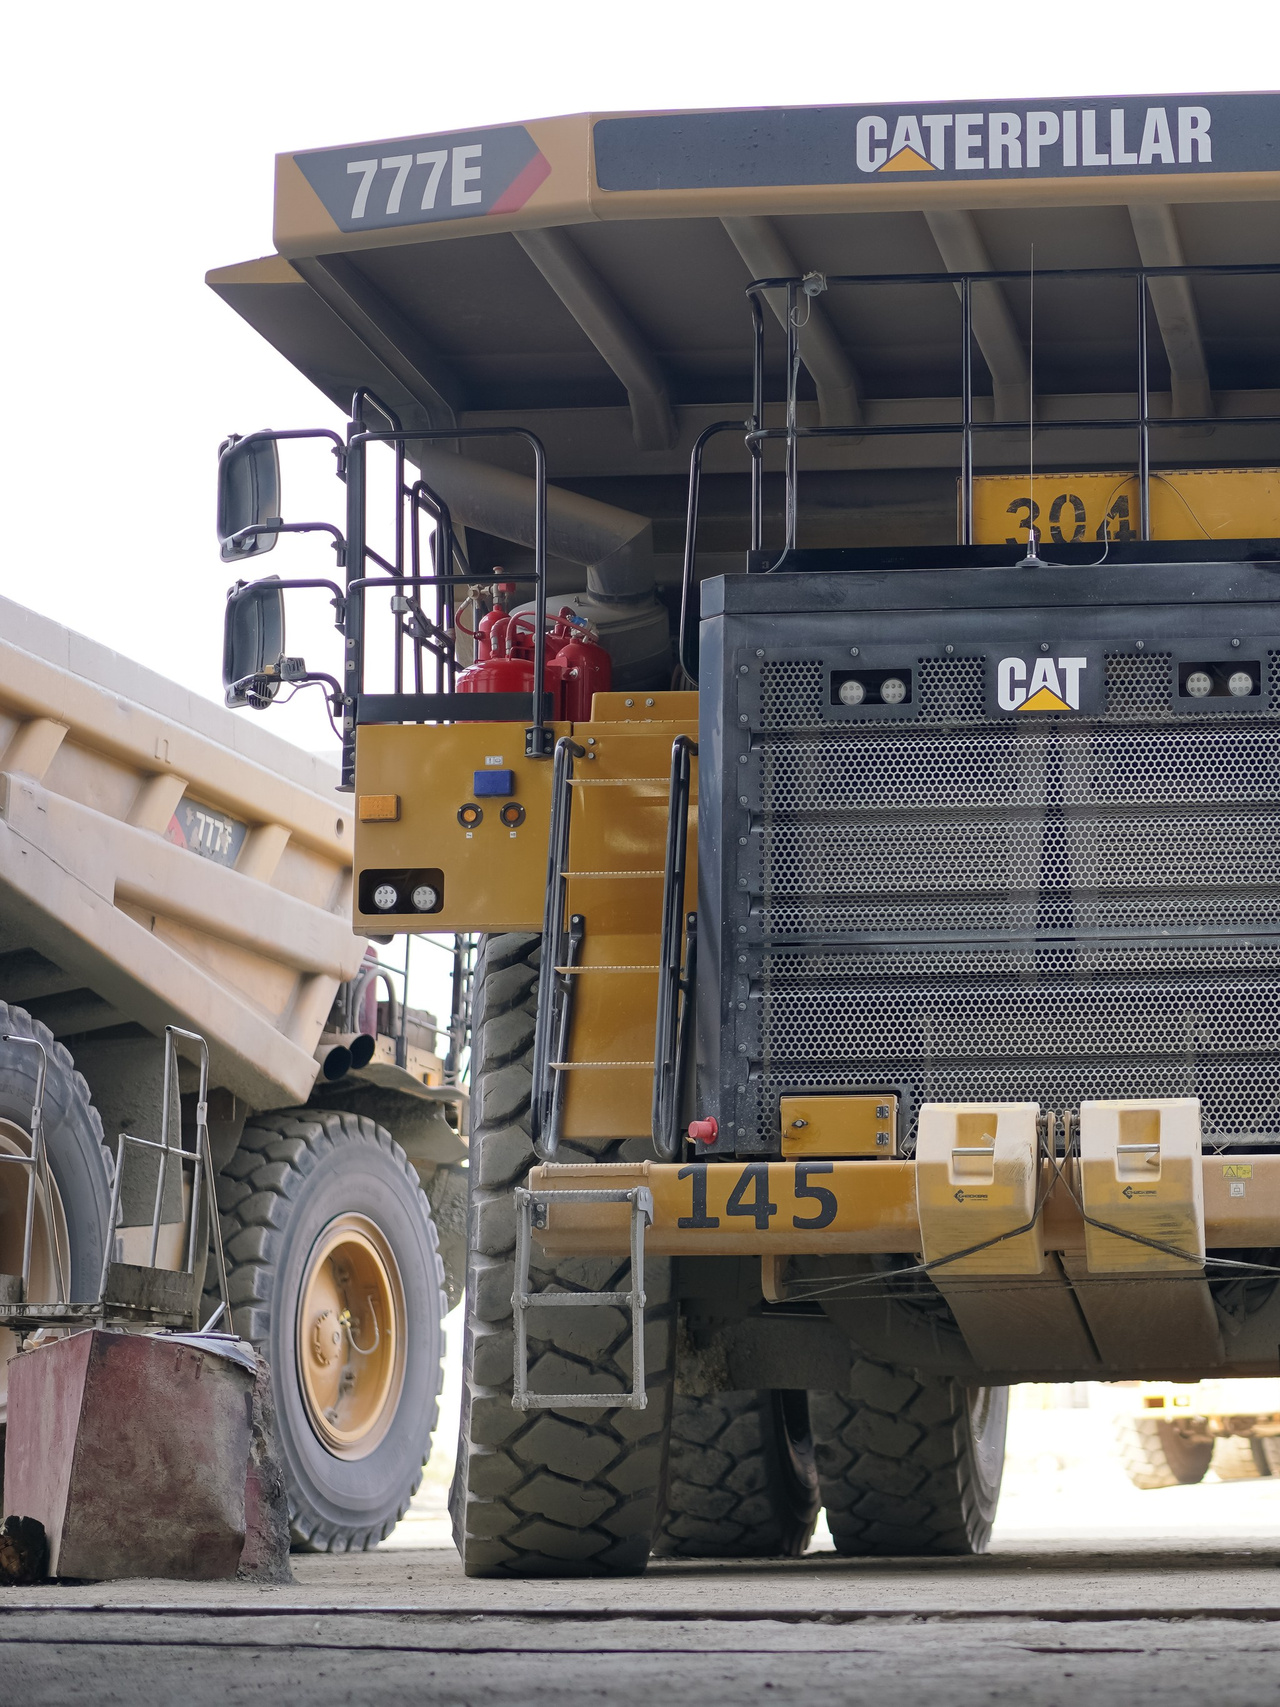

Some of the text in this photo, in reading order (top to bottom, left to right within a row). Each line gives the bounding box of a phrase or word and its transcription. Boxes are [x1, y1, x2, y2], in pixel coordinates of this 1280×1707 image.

[856, 106, 1213, 173] CATERPILLAR
[347, 144, 482, 219] 777E
[1006, 493, 1137, 544] 304
[998, 657, 1087, 711] CAT
[677, 1162, 838, 1230] 145
